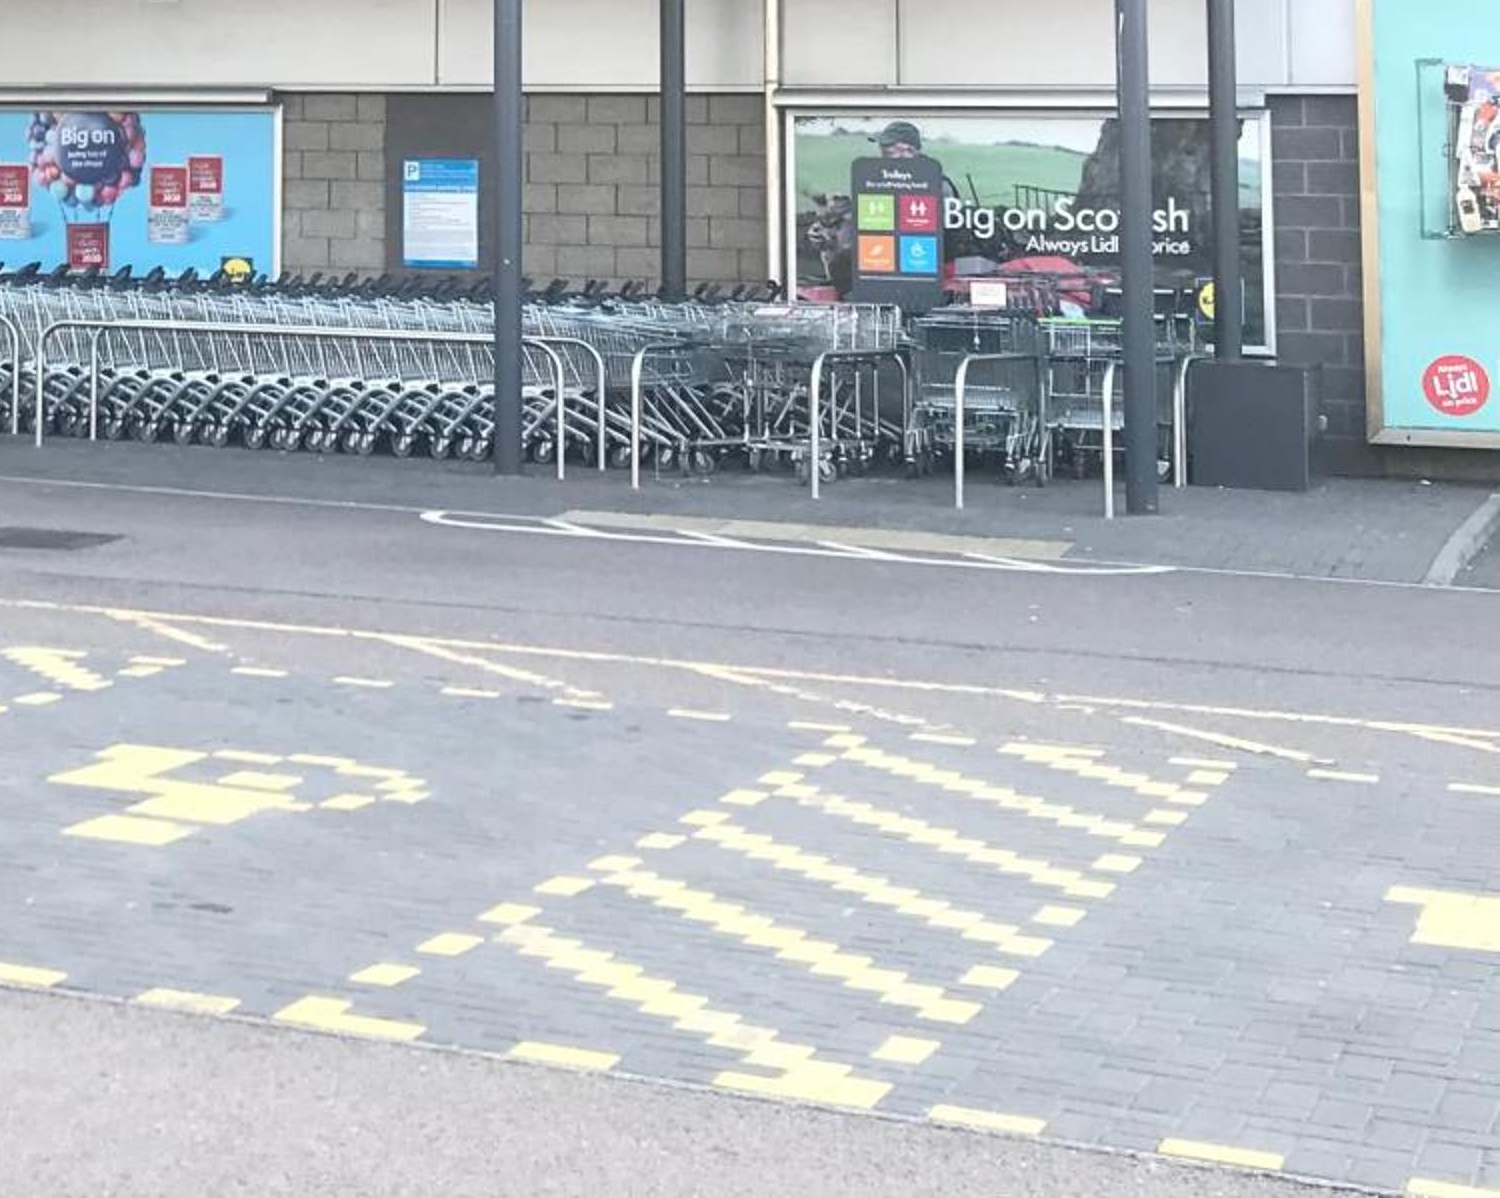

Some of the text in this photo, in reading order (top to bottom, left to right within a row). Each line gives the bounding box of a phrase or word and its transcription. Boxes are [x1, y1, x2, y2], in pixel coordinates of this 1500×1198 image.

[61, 126, 115, 149] Big on
[407, 164, 416, 178] P
[944, 197, 1189, 239] Big on Scosh
[1025, 235, 1088, 256] Always
[1091, 236, 1120, 253] Lidl
[1433, 370, 1478, 399] Lidl
